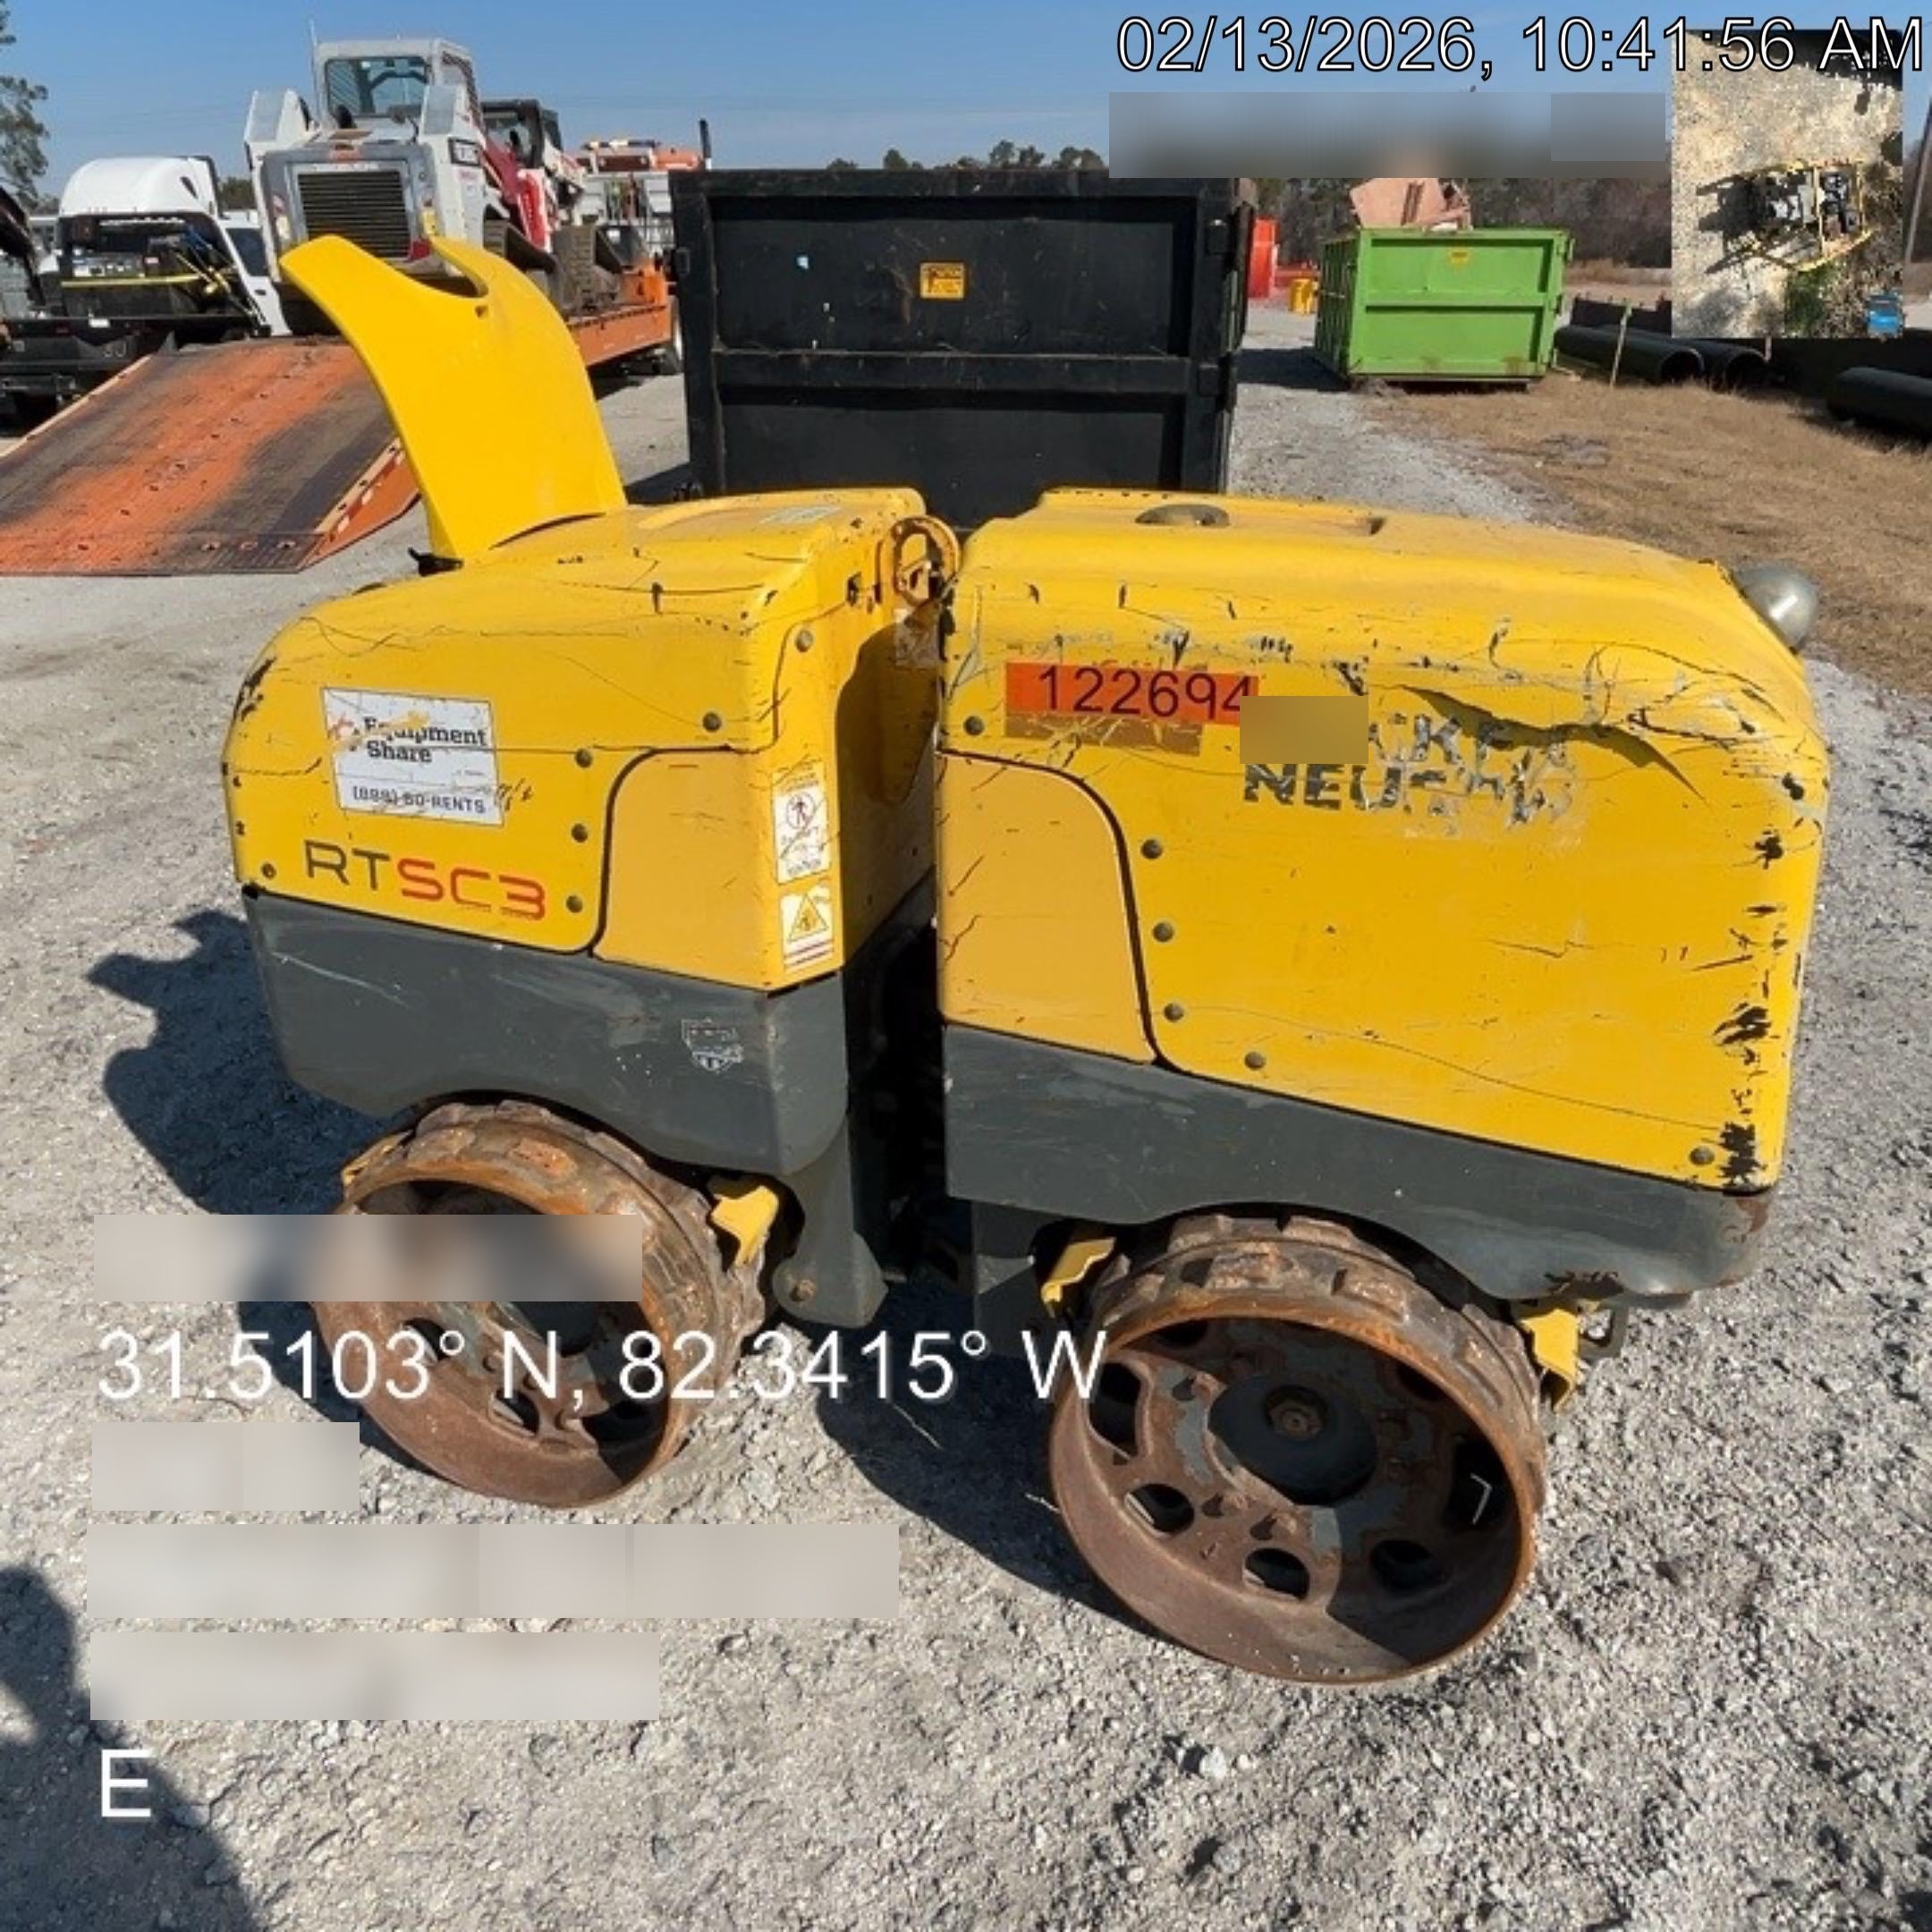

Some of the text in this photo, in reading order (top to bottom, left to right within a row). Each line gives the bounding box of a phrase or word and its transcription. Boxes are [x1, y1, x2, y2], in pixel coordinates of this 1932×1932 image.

[1038, 665, 1250, 719] 122694
[363, 716, 487, 746] Euipment
[367, 740, 433, 763] Share
[304, 839, 546, 921] RTSC3
